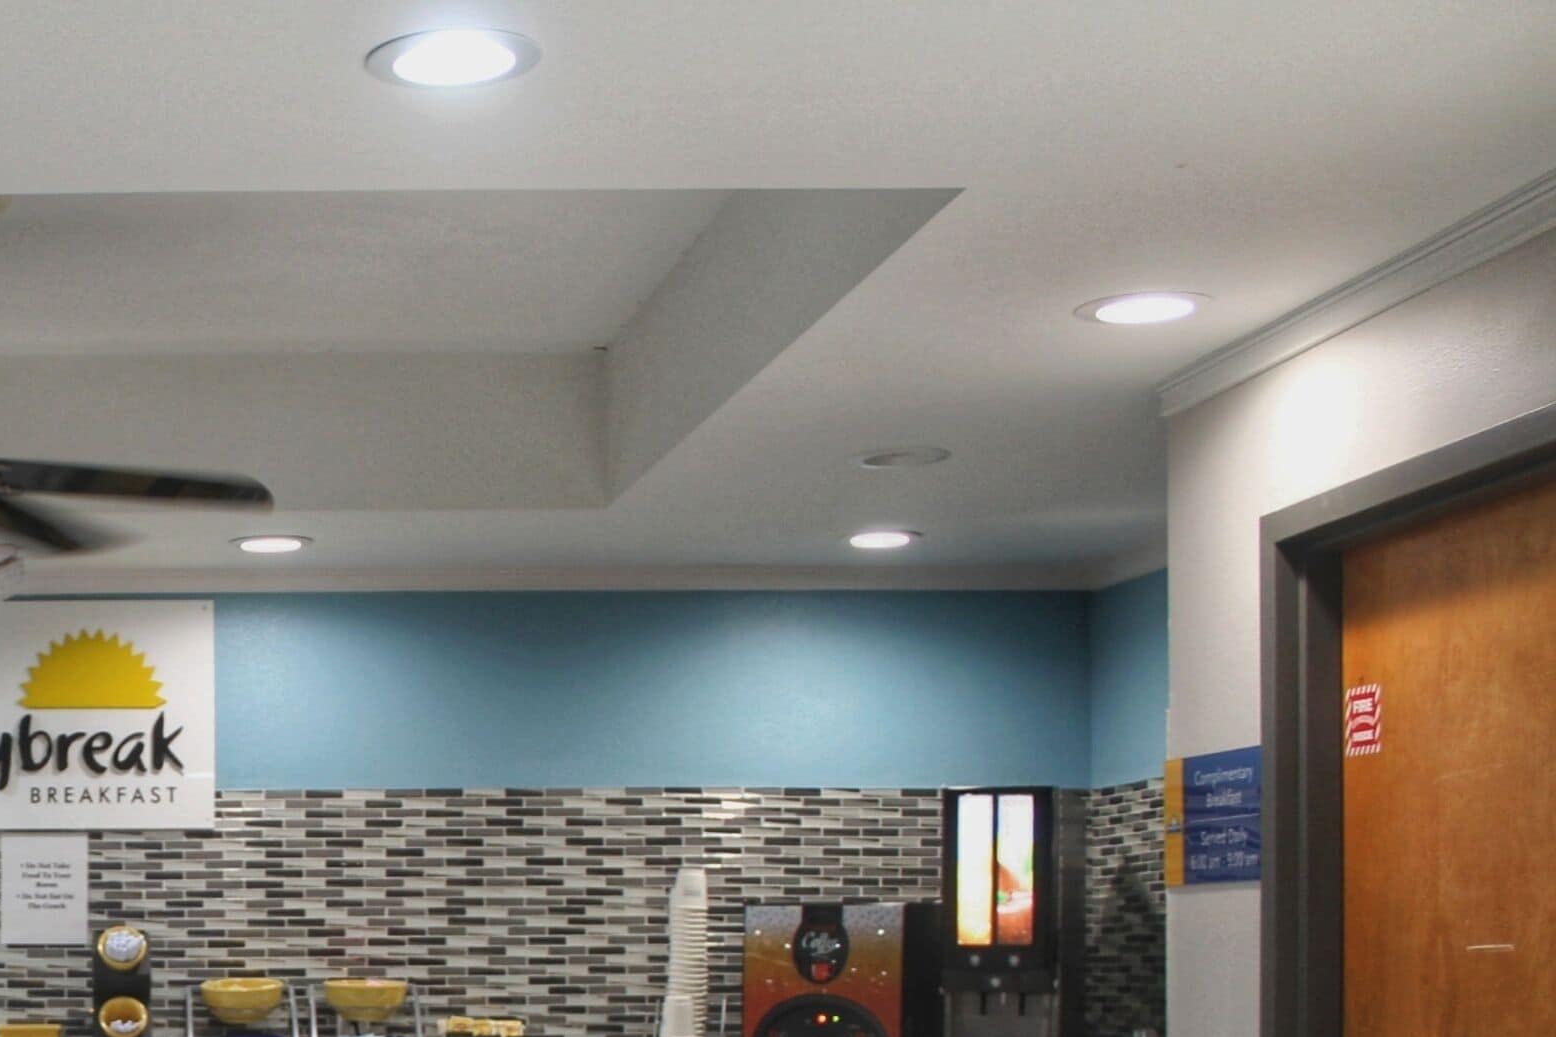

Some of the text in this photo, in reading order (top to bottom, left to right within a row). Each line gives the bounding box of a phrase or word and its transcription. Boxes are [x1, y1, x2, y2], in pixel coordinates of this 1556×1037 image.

[1352, 697, 1374, 715] FIRE
[1194, 767, 1253, 788] Complimentary
[30, 786, 177, 804] BREAKFAST
[1206, 788, 1243, 808] Breakfast
[1200, 829, 1227, 846] Served
